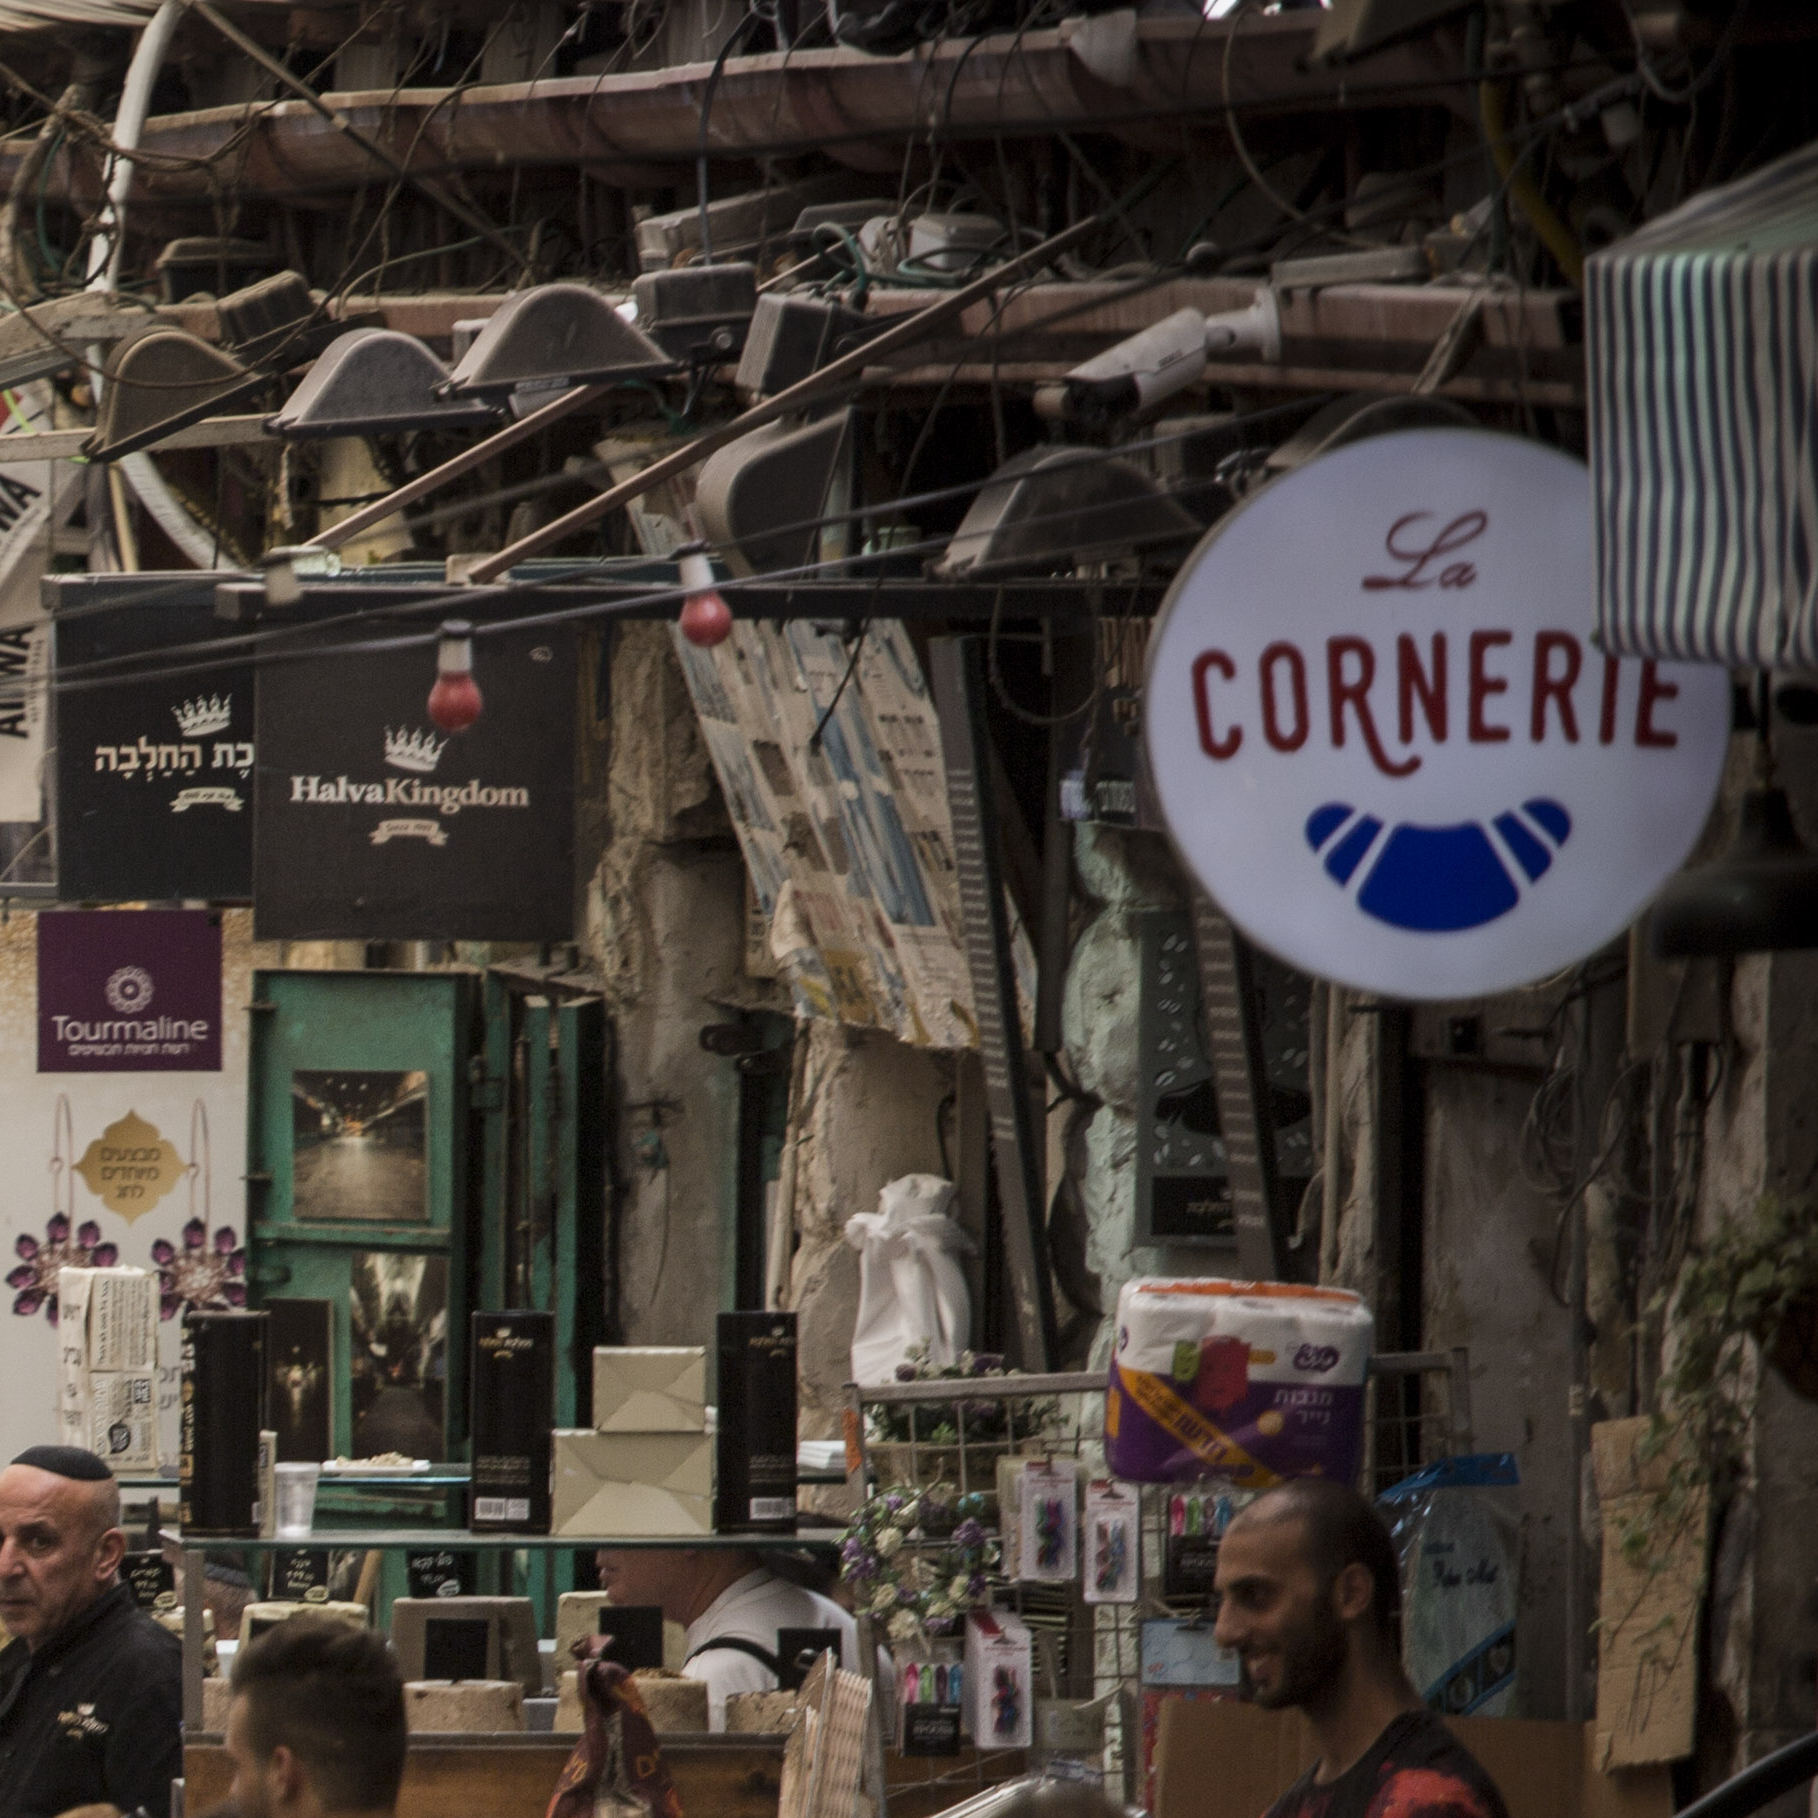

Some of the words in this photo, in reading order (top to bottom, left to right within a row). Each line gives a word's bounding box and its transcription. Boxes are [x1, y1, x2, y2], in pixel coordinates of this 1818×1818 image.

[1362, 508, 1489, 594] La
[1191, 629, 1680, 780] CORNERIE
[289, 775, 531, 814] HalvaKingdom
[51, 1015, 209, 1042] Tourmaline
[99, 1146, 162, 1162] מבצעים
[100, 1166, 160, 1181] מיוחדים
[115, 1183, 145, 1199] לחג
[1274, 1388, 1334, 1406] מגבות
[1297, 1409, 1332, 1426] נייר
